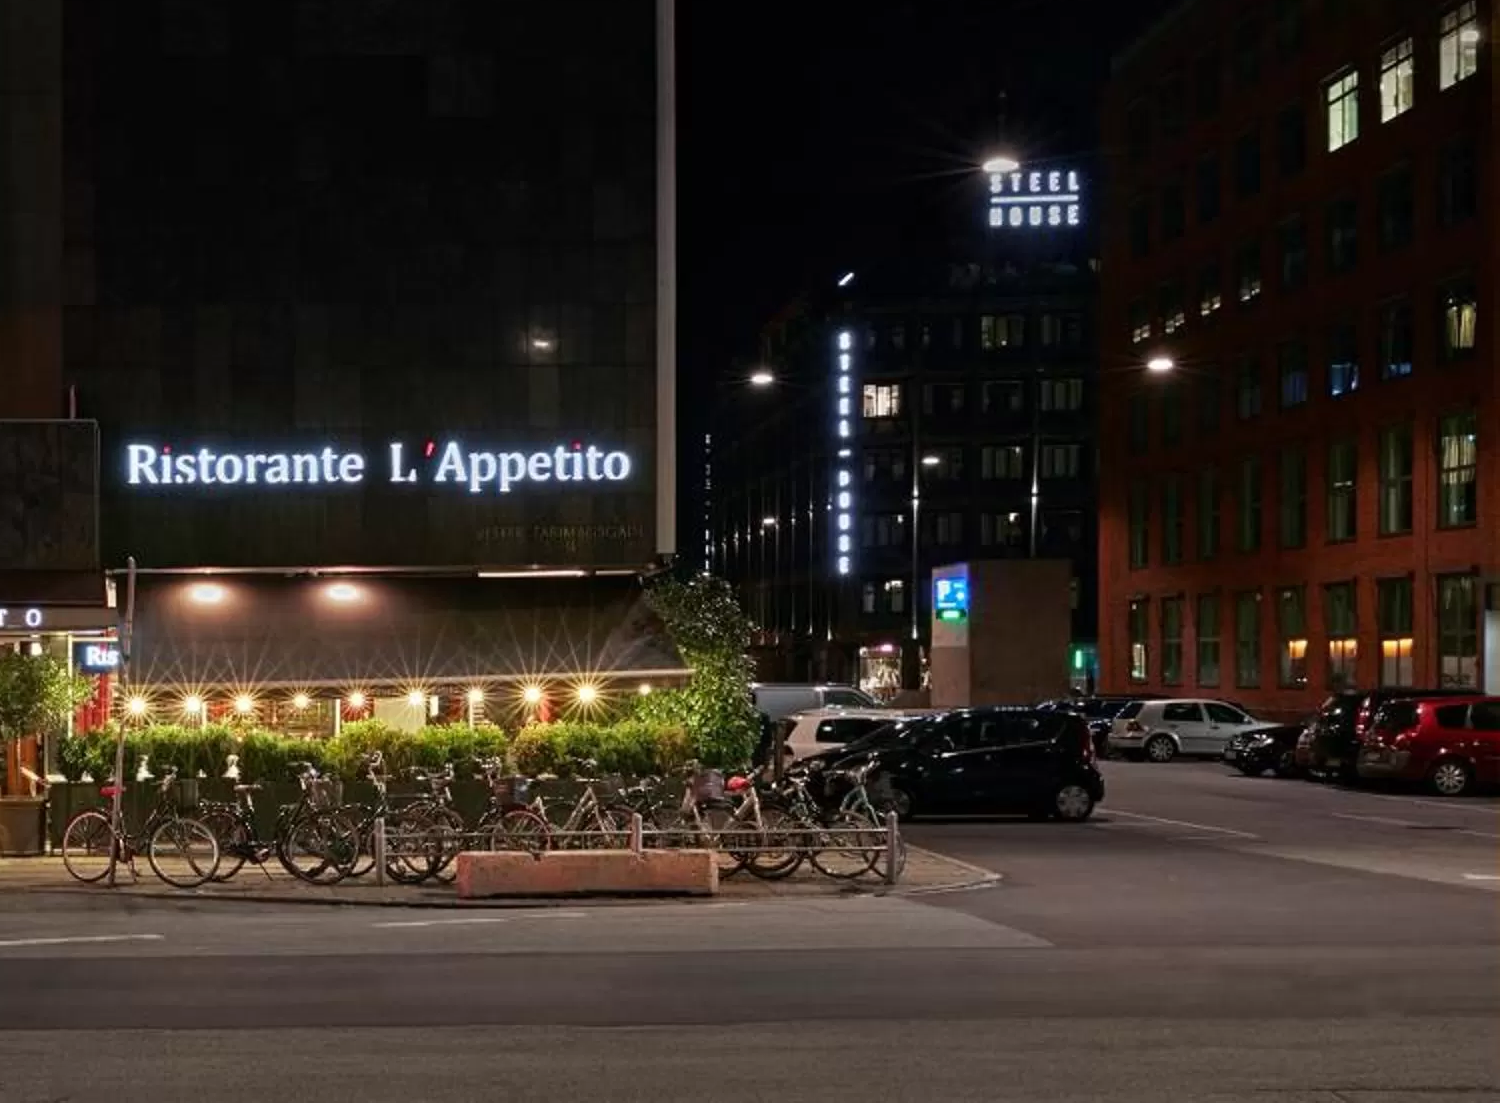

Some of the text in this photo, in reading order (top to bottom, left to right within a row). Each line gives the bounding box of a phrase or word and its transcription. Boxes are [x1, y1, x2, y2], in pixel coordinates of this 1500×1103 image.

[989, 172, 1080, 193] STEEL
[988, 204, 1080, 226] HOUSE
[128, 441, 631, 492] Ristorante L'Appetito
